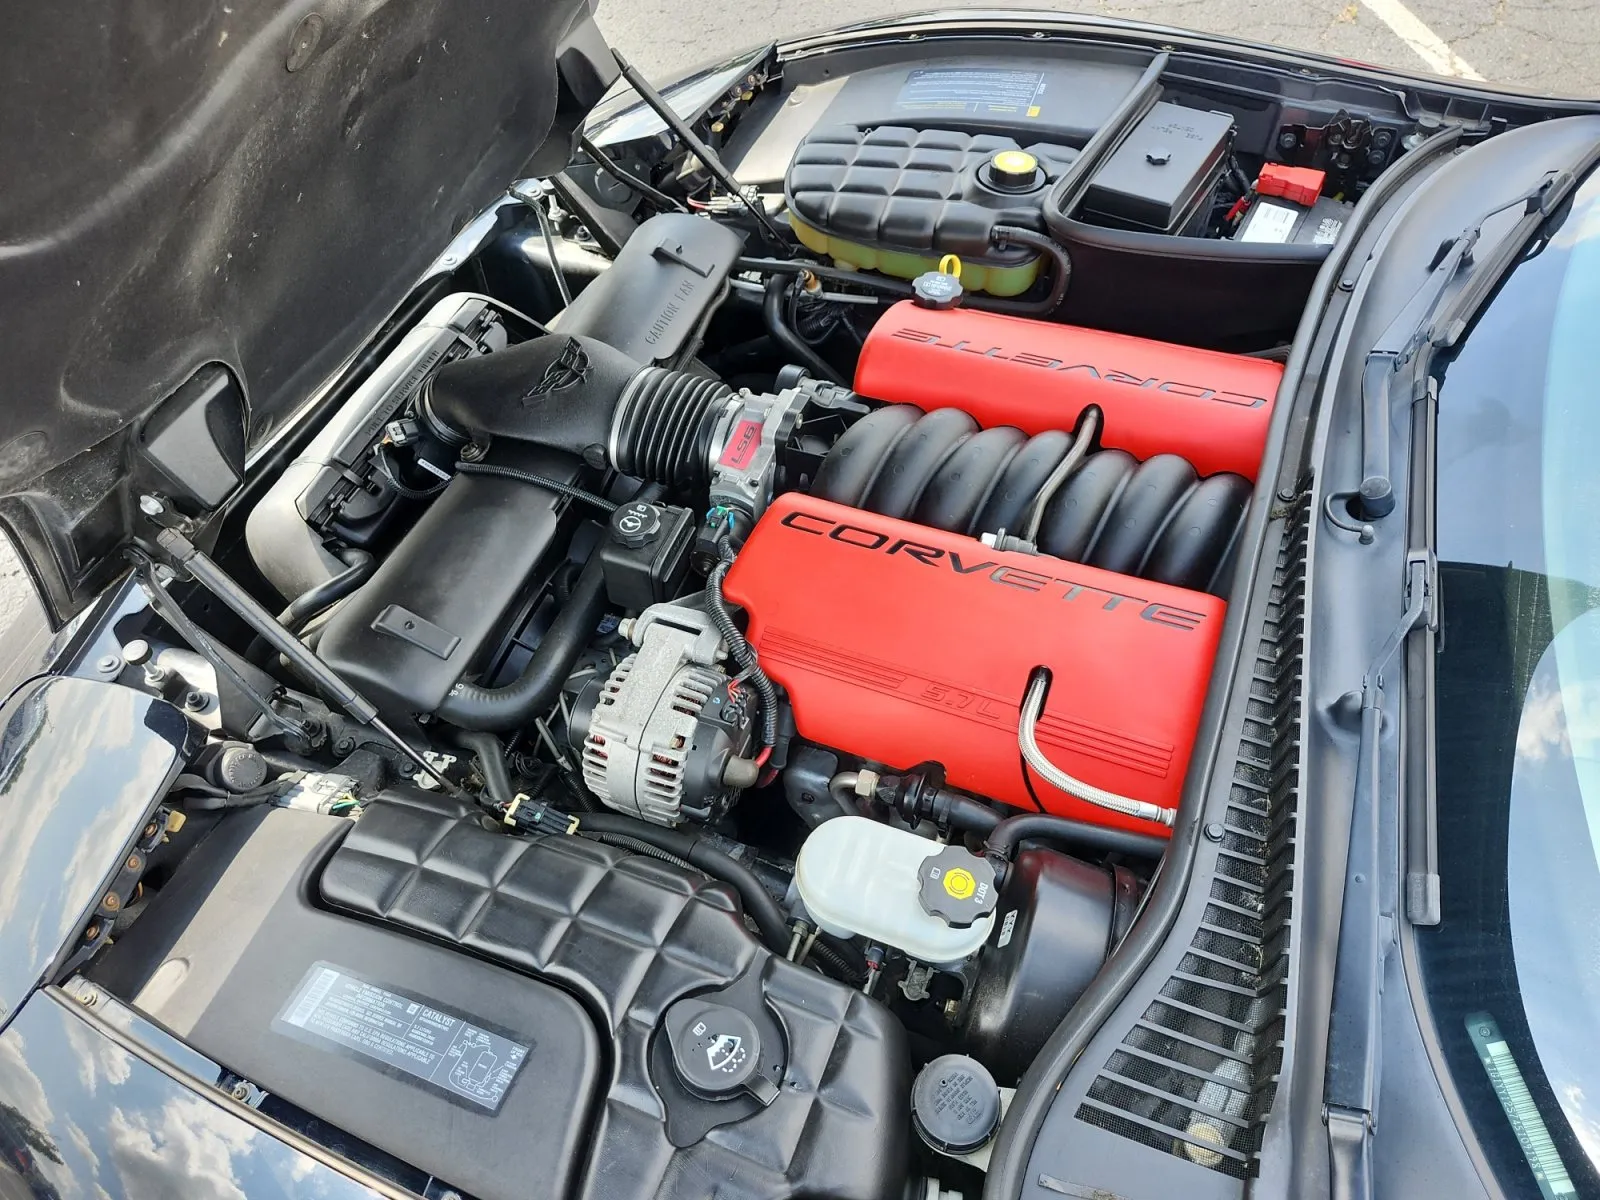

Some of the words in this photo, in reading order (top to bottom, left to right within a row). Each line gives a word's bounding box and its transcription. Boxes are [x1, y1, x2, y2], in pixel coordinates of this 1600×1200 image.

[645, 302, 680, 345] CAUTION
[675, 280, 695, 302] FAN
[890, 326, 1268, 410] CORVETTE
[382, 403, 395, 416] TO
[391, 374, 419, 406] SERVICE
[731, 424, 756, 464] LS6
[780, 510, 1208, 631] CORVETTE
[919, 682, 1001, 720] 5.7L
[978, 882, 989, 899] DOT
[381, 997, 404, 1009] CONTROL
[420, 1008, 455, 1027] CATALYST
[1487, 1066, 1541, 1169] 1G1YY12S745109198
